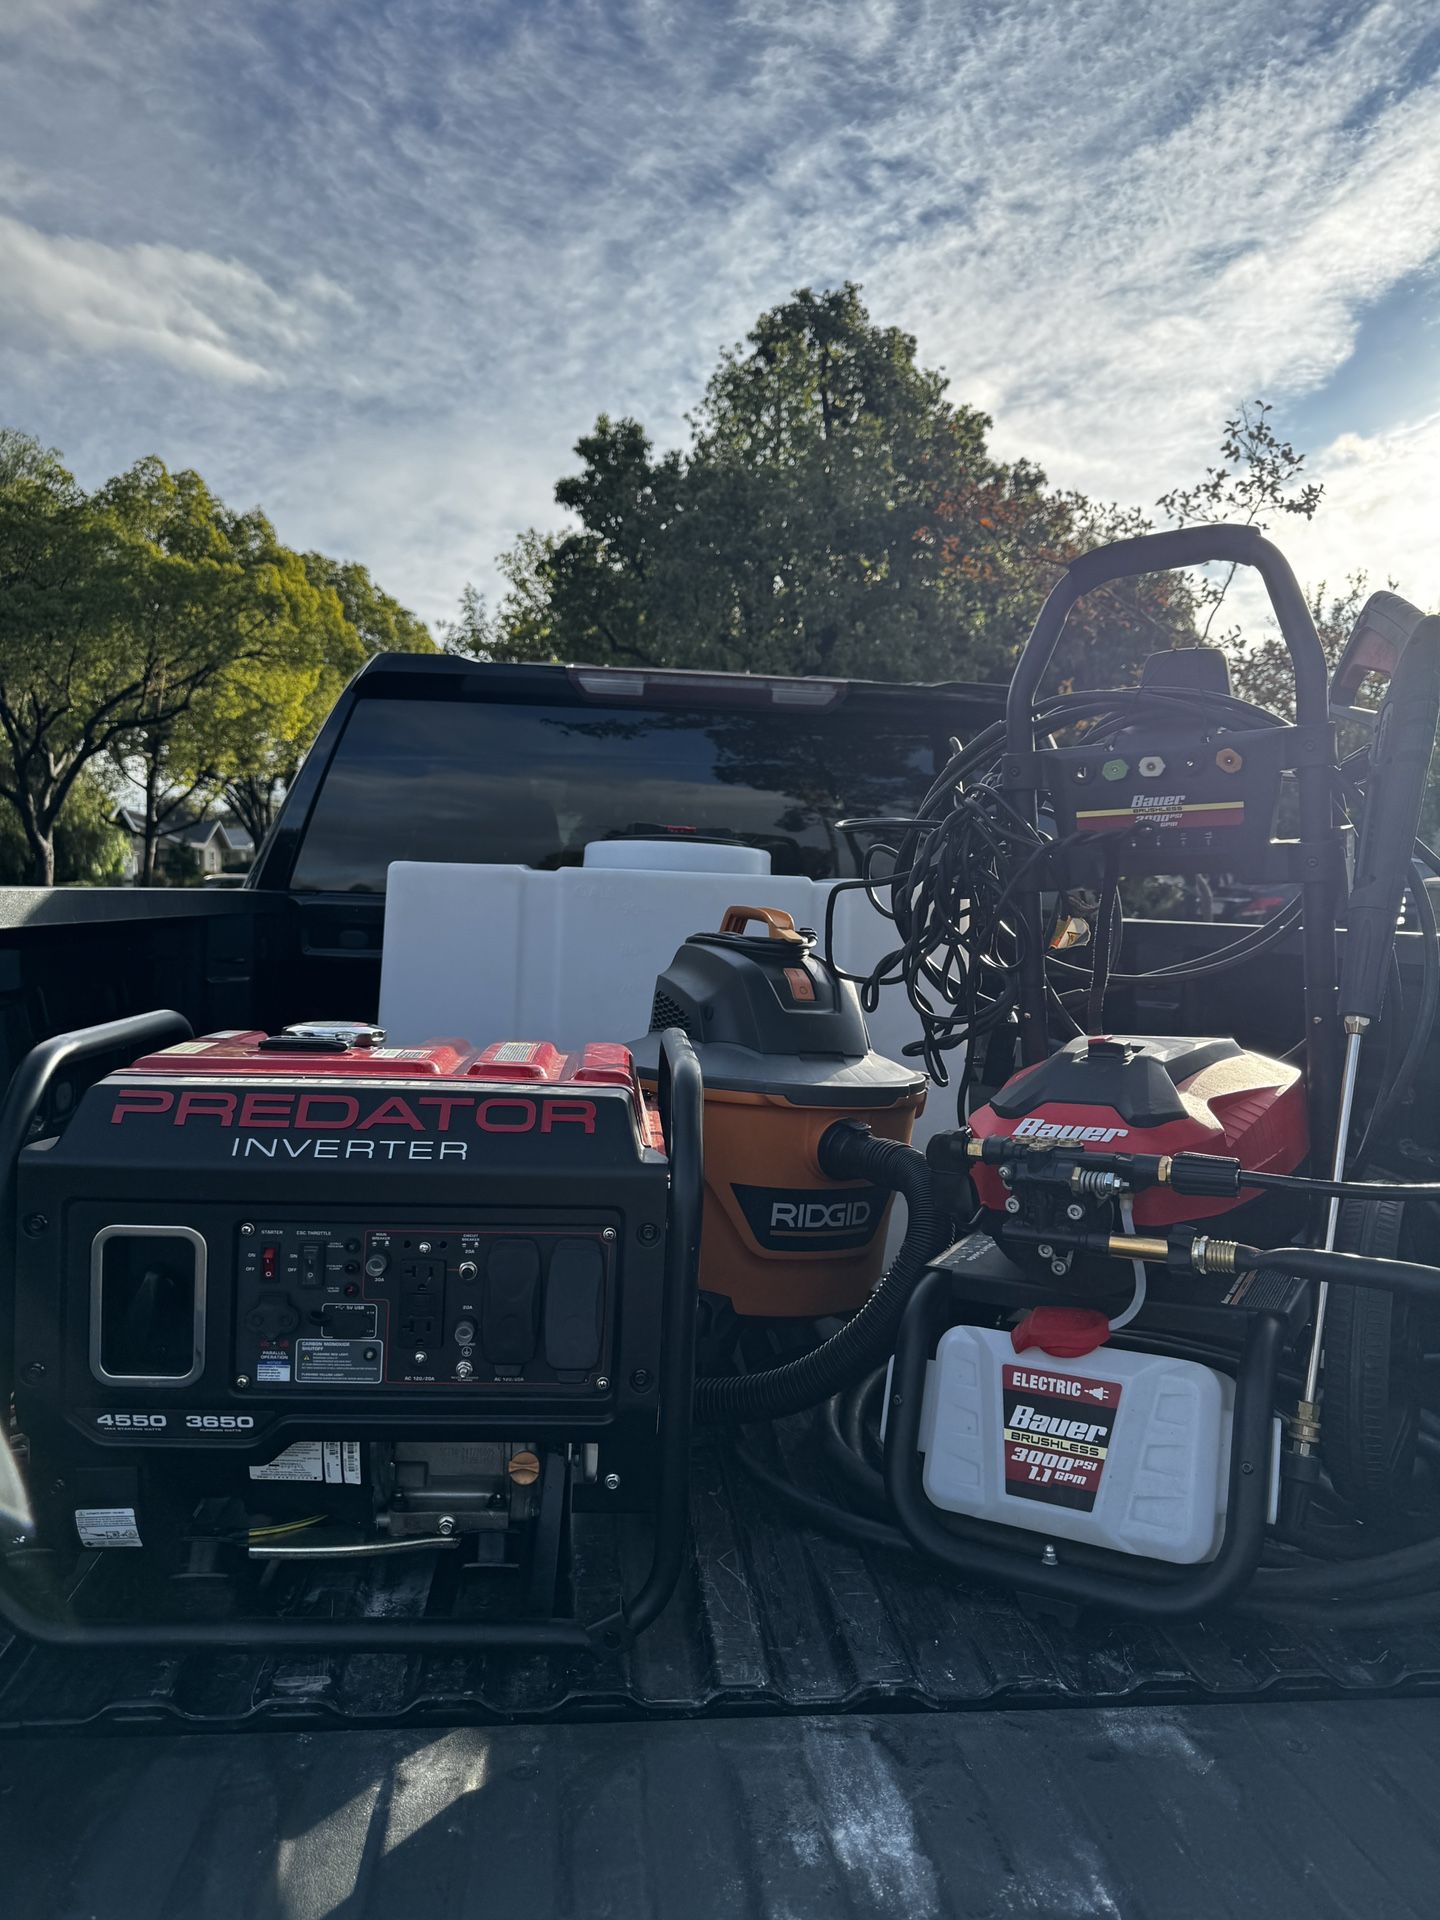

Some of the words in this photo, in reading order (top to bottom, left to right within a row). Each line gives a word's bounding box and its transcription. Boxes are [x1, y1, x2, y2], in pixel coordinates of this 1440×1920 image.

[1131, 795, 1185, 808] Bauer
[1132, 806, 1182, 814] BRUSHLESS
[110, 1089, 597, 1134] PREDATOR
[1012, 1117, 1128, 1143] Bauer
[231, 1138, 468, 1161] INVERTER
[770, 1201, 871, 1229] RIDGID
[1012, 1372, 1082, 1397] ELECTRIC
[97, 1414, 167, 1427] 4550
[186, 1415, 254, 1428] 3650
[1009, 1404, 1108, 1443] Bauer
[1011, 1431, 1100, 1457] BRUSHLESS
[1028, 1465, 1053, 1483] 1.1
